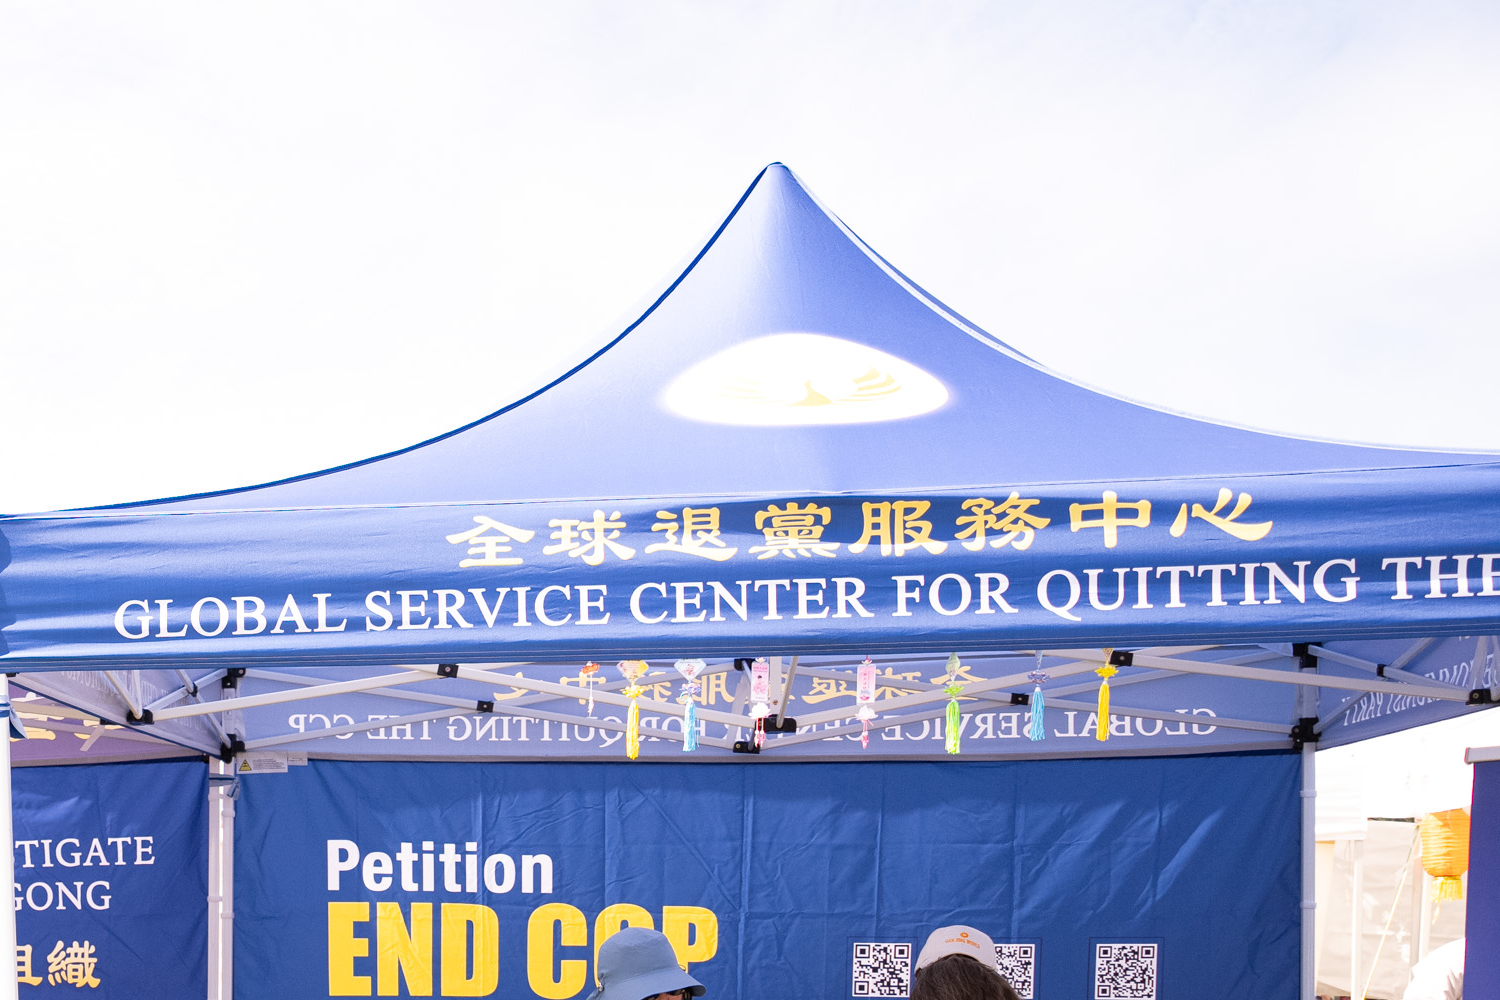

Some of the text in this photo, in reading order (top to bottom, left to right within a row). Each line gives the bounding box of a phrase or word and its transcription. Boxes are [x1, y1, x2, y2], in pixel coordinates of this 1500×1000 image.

[445, 486, 1275, 569] 全球退黨服務中心
[113, 553, 1500, 640] GLOBAL SERVICE CENTER FOR QUITTING THE
[326, 839, 553, 894] Petition
[328, 902, 500, 997] END
